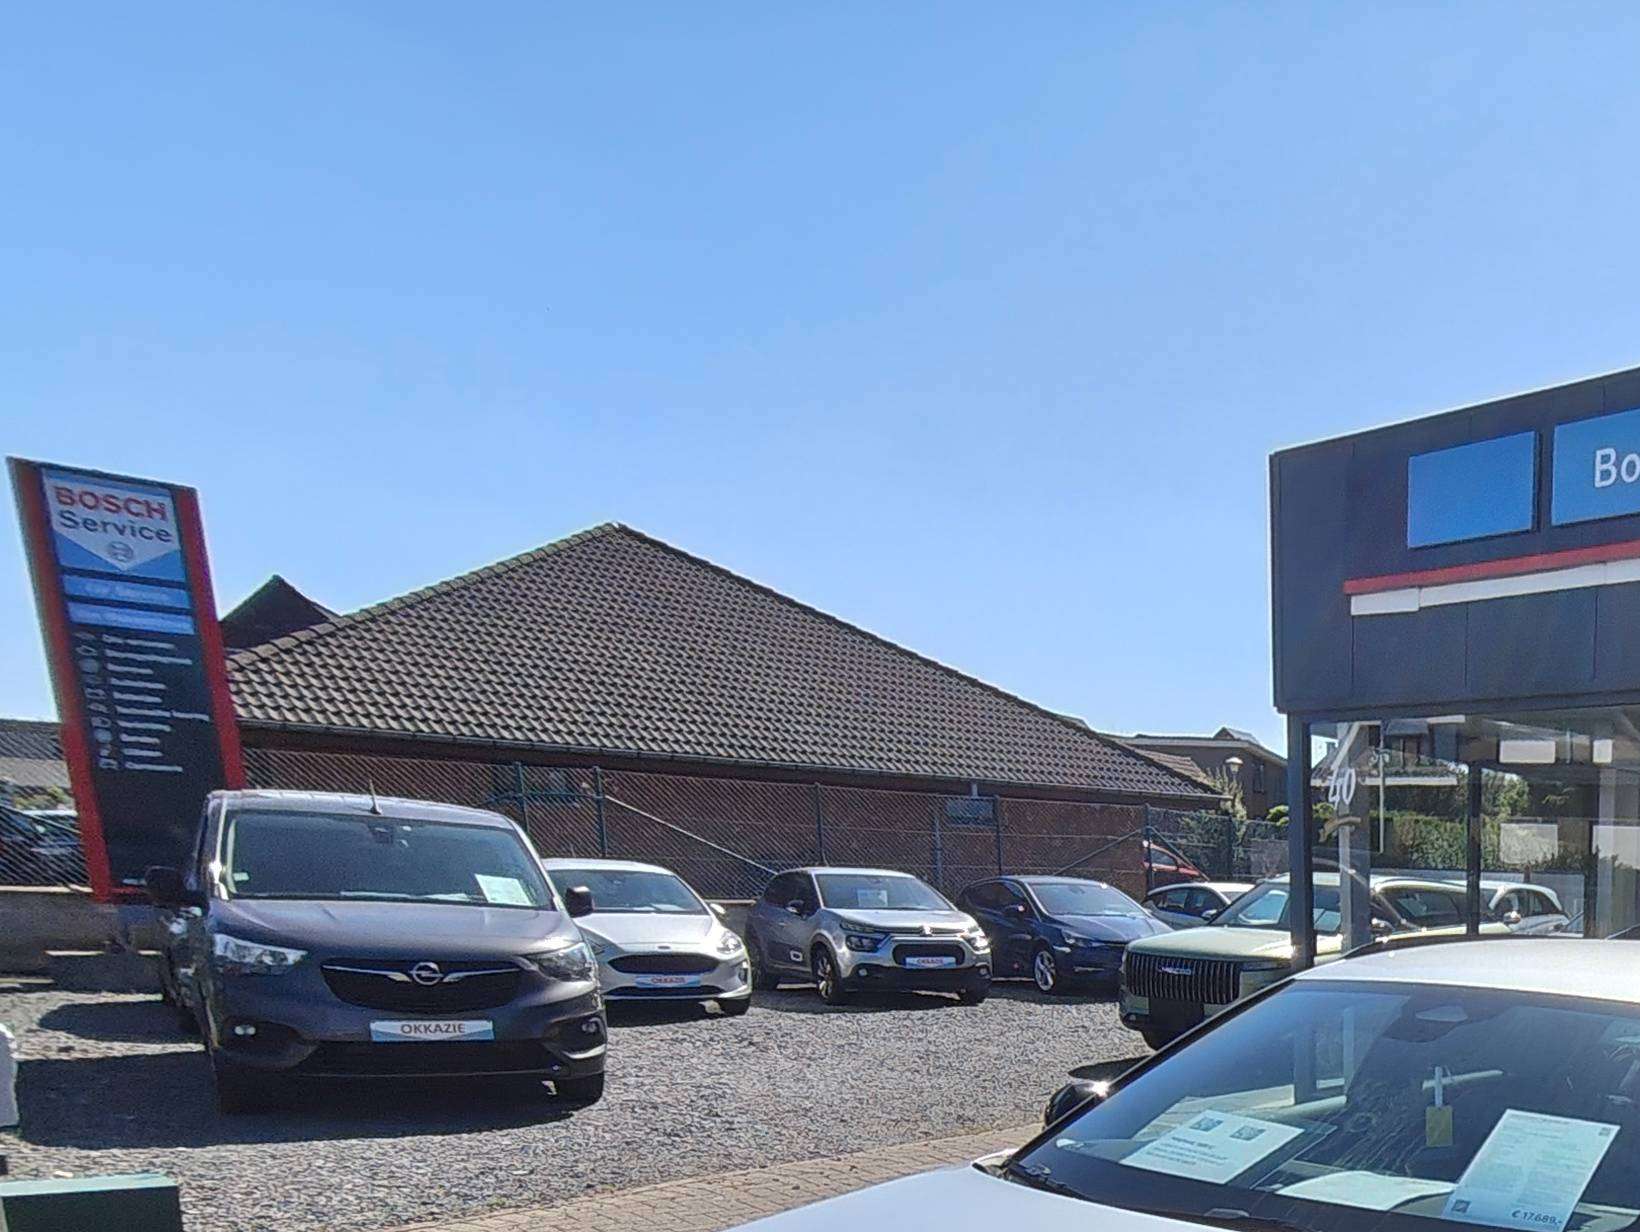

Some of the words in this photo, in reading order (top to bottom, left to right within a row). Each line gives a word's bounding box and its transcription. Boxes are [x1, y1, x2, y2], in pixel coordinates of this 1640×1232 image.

[54, 485, 168, 522] BOSCH
[57, 509, 173, 543] Service
[400, 1023, 466, 1035] OKKAZIE
